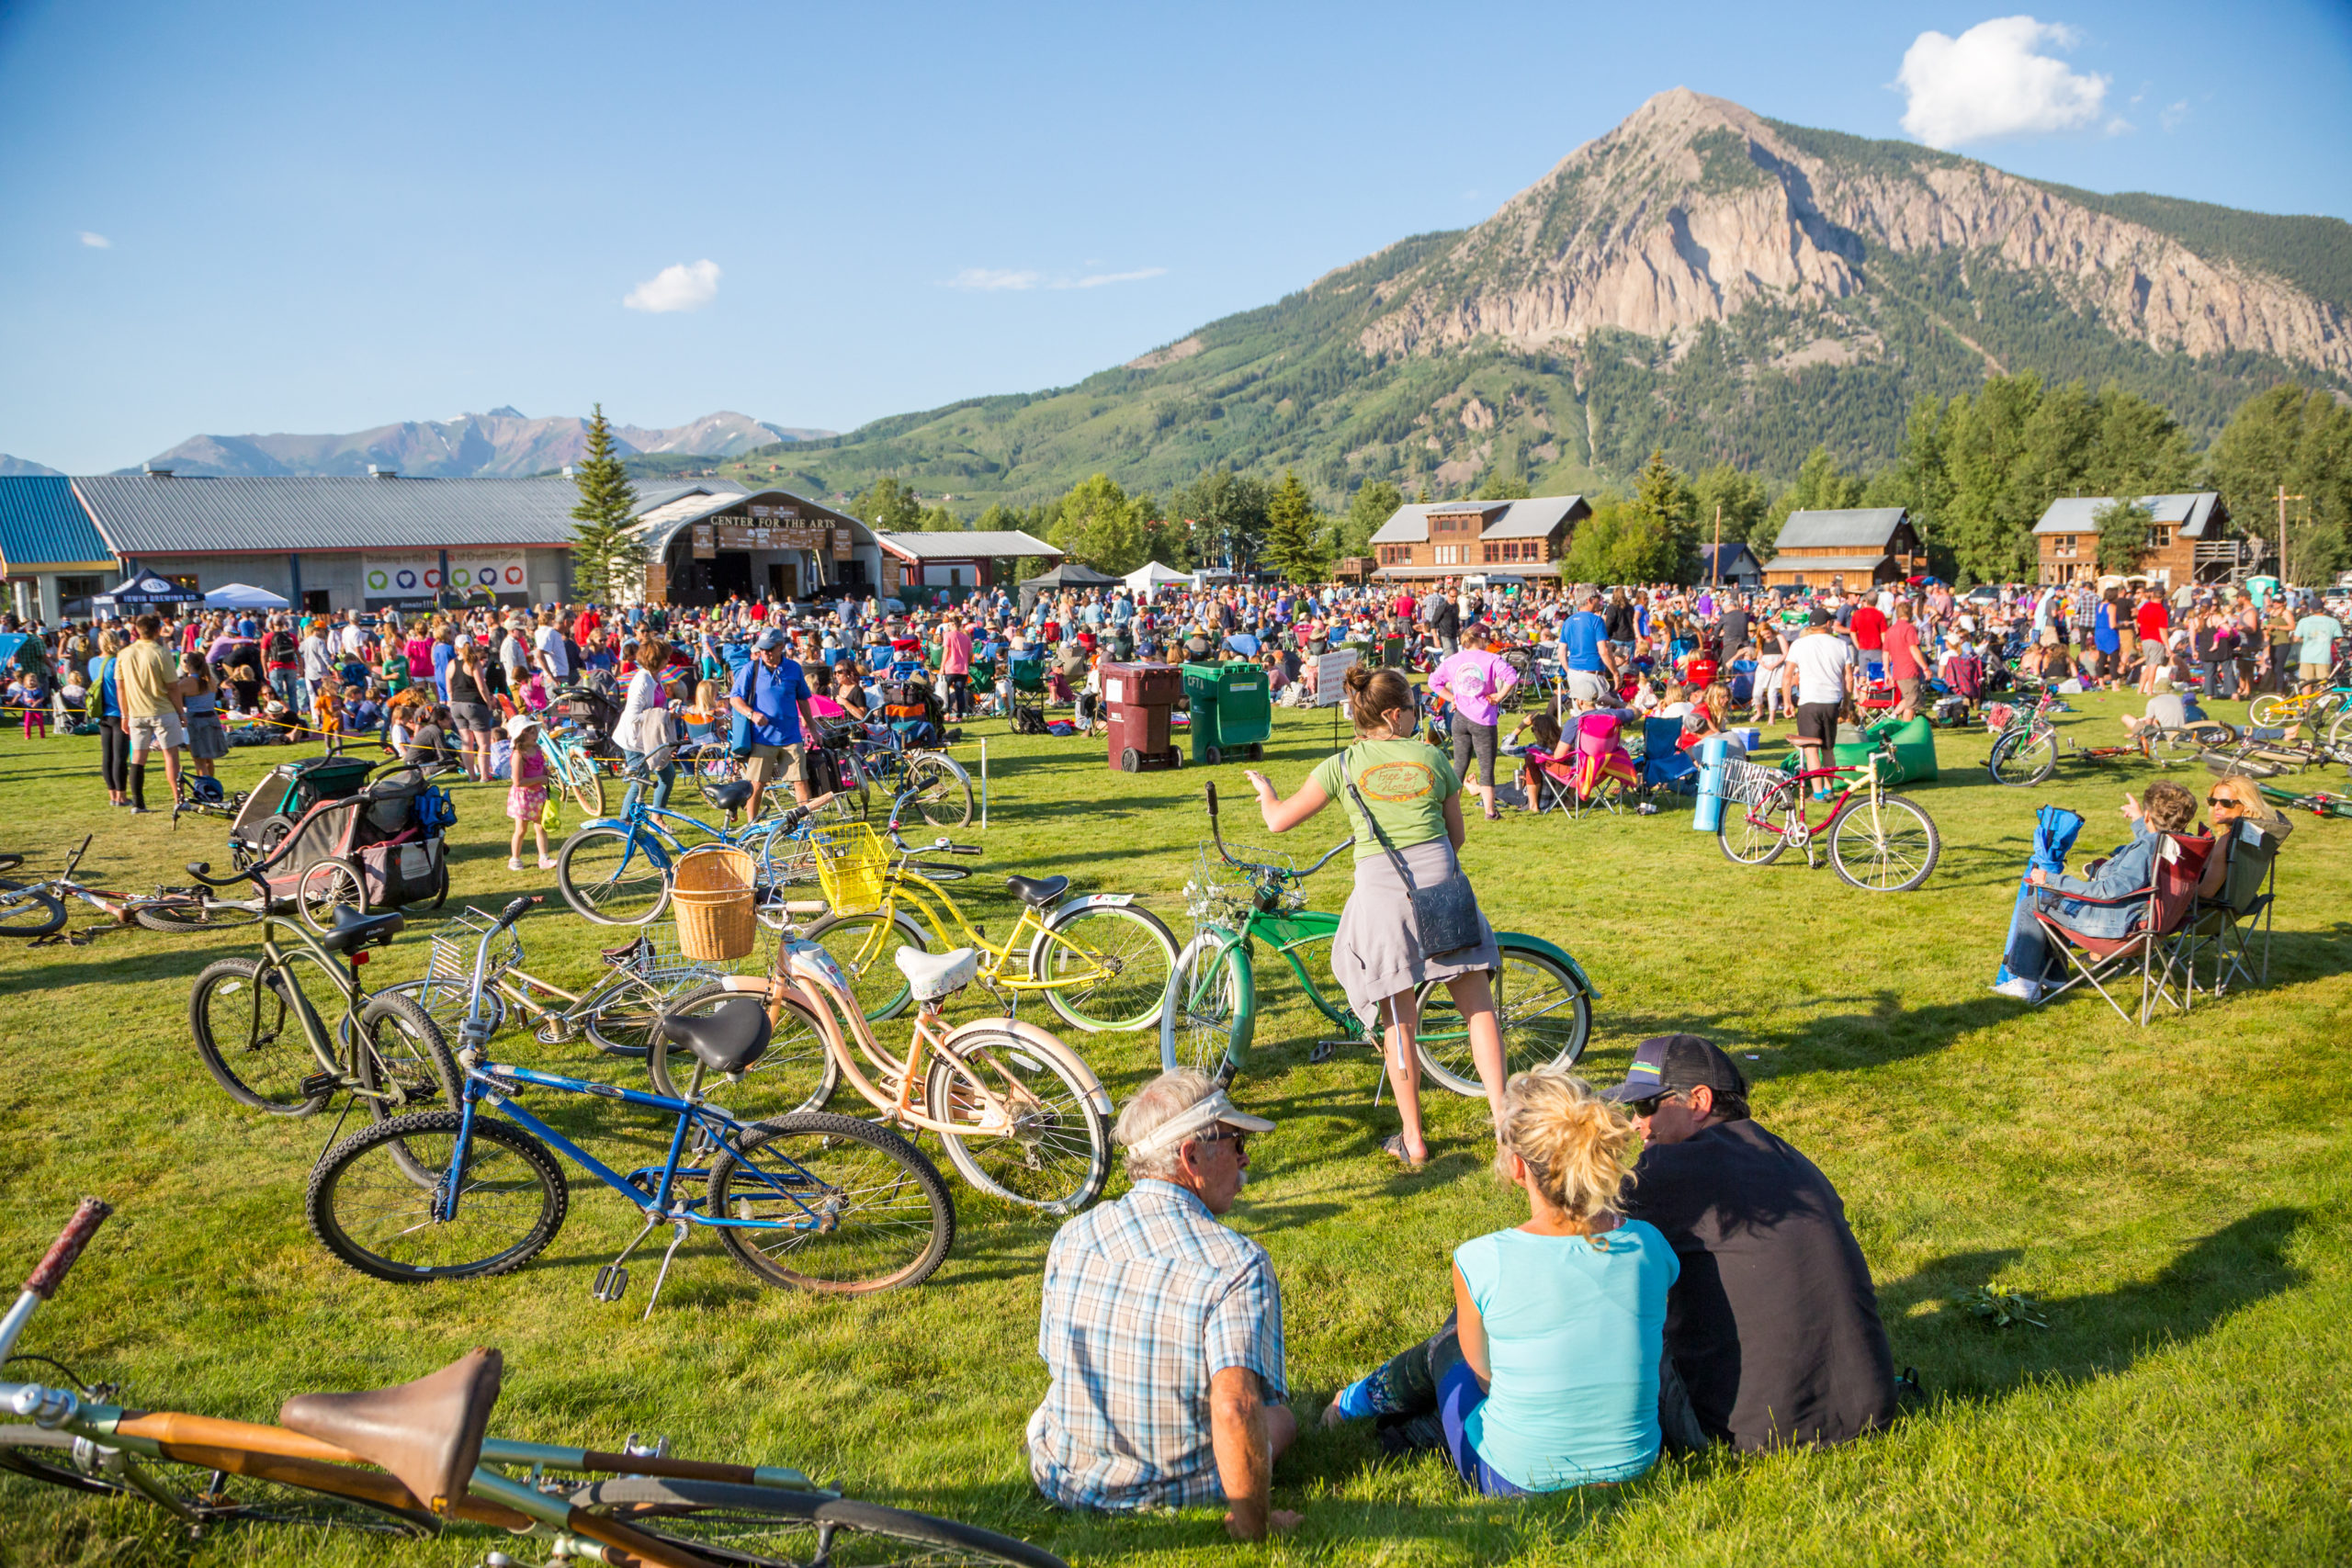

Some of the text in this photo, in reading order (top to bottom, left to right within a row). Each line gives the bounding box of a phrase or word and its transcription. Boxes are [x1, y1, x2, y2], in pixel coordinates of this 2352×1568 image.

[710, 515, 836, 529] CENTER FOR THE ARTS
[123, 594, 147, 603] IRWIN
[149, 594, 184, 603] BREWING
[1377, 768, 1403, 781] Free
